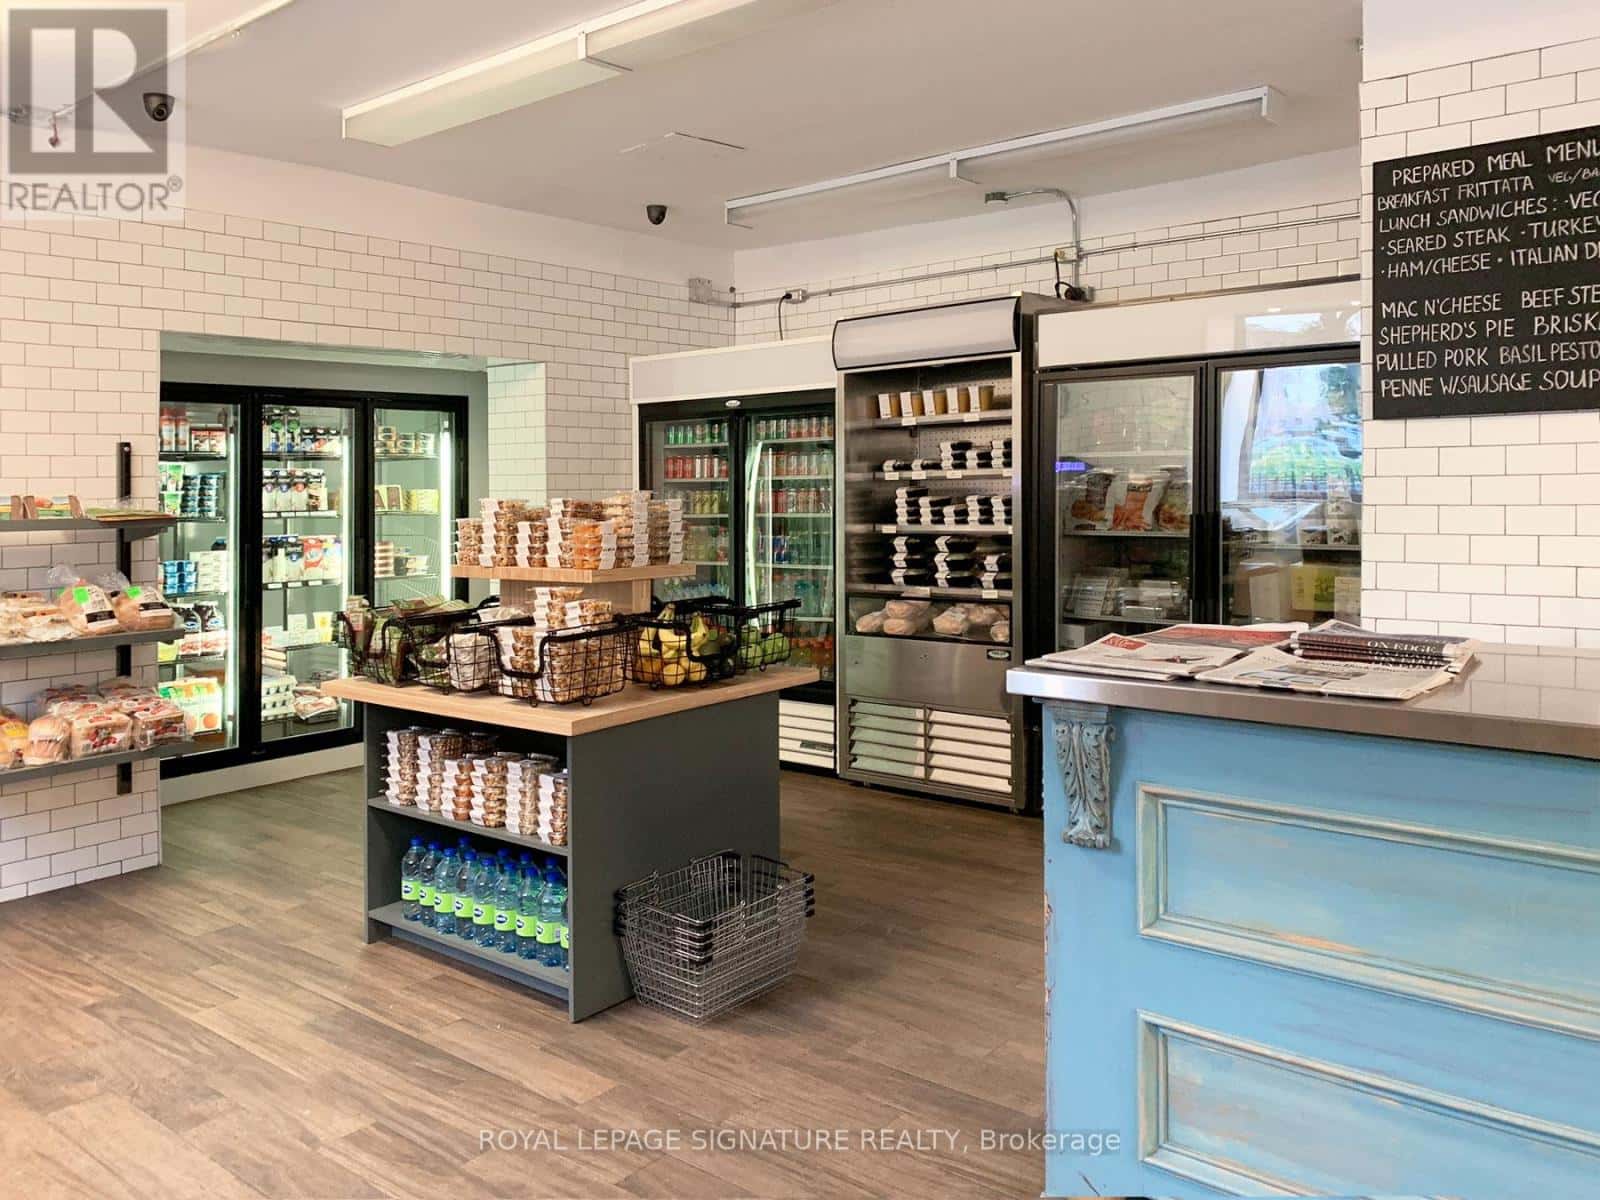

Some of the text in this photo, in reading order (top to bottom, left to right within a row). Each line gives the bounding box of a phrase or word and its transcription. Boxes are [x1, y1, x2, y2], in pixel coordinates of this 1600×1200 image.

[1392, 159, 1475, 186] PREPARED
[1488, 150, 1533, 172] MEAL
[1377, 167, 1600, 211] BREAKFAST FRITTATA VEG/BA
[1379, 213, 1431, 233] LUNCH
[1386, 234, 1447, 256] SEARED
[1453, 226, 1512, 248] STEAK
[1387, 252, 1492, 279] HAM/CHEESE
[1510, 243, 1578, 266] ITALIAN
[1381, 300, 1418, 319] MAC
[1424, 293, 1502, 316] N'CHEESE
[1521, 287, 1565, 309] BEEF
[1378, 311, 1600, 346] SHEPHERD'S PIE BRISK
[1376, 340, 1600, 373] PULLED PORK BASIL PESTO
[1380, 368, 1600, 397] PENNE W/SAUSAGE SOUP
